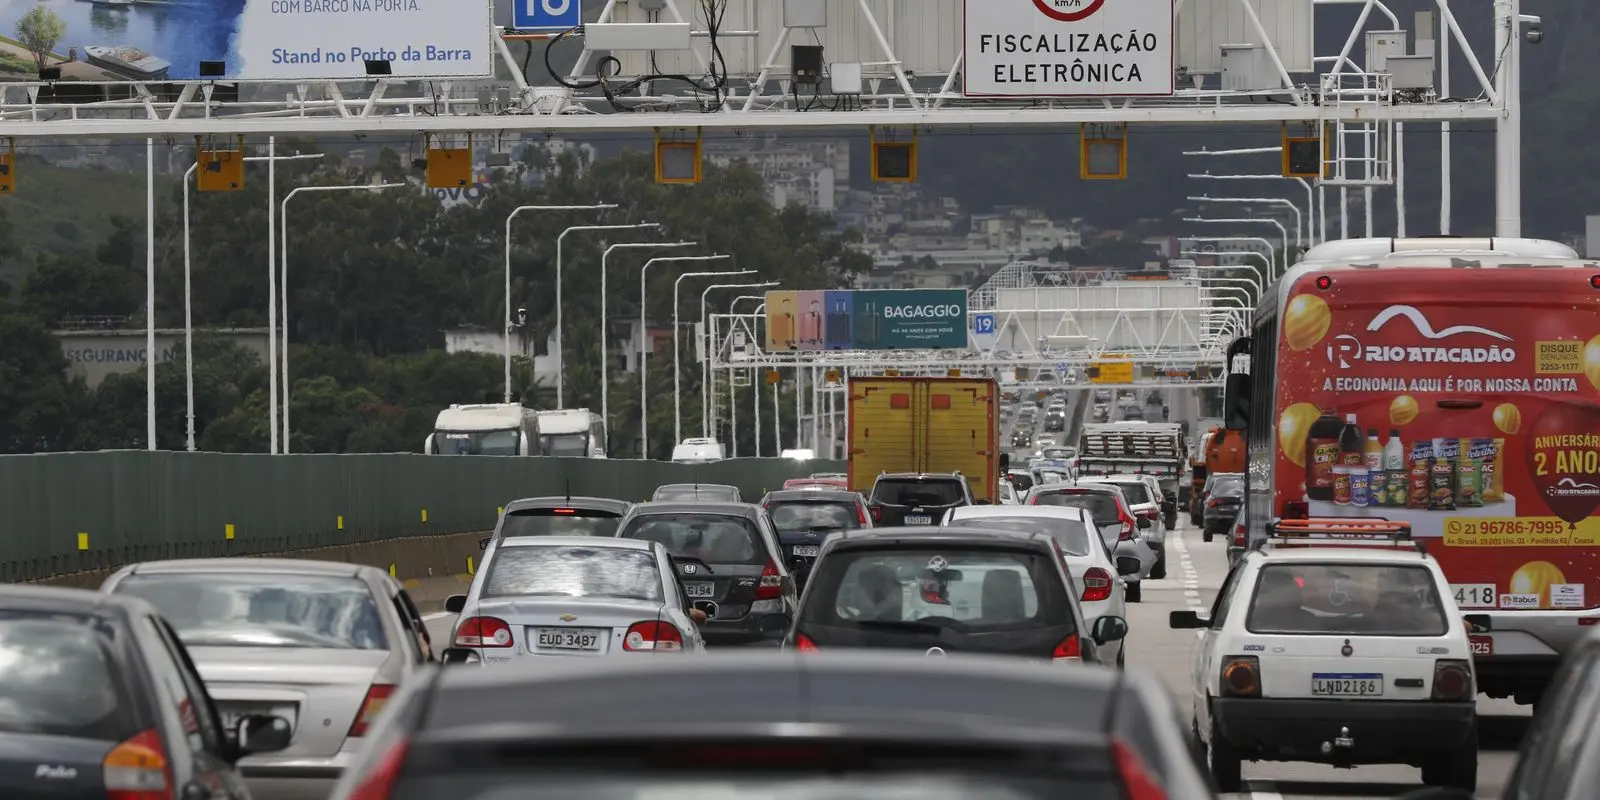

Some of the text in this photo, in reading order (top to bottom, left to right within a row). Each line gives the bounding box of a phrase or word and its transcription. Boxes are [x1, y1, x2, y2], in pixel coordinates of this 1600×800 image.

[271, 0, 421, 13] COM BARCO NA PORTA.
[980, 30, 1157, 54] FISCALIZAÇÃO
[272, 45, 472, 64] Stand no Porto da Barra
[994, 58, 1142, 82] ELETRÔNICA
[884, 304, 961, 318] BAGAGGIO
[977, 318, 992, 331] 19
[1366, 345, 1405, 362] RIO
[1407, 344, 1516, 363] ATACADÃO
[1540, 344, 1579, 353] DISQUE
[1540, 362, 1580, 371] 2253-1177
[1323, 375, 1578, 392] A ECONOMIA AQUI É POR NOSSA CONTA
[1535, 432, 1600, 449] ANIVERSÁR
[1534, 450, 1600, 476] 2 ANO
[1464, 520, 1563, 535] 21 96786-7995
